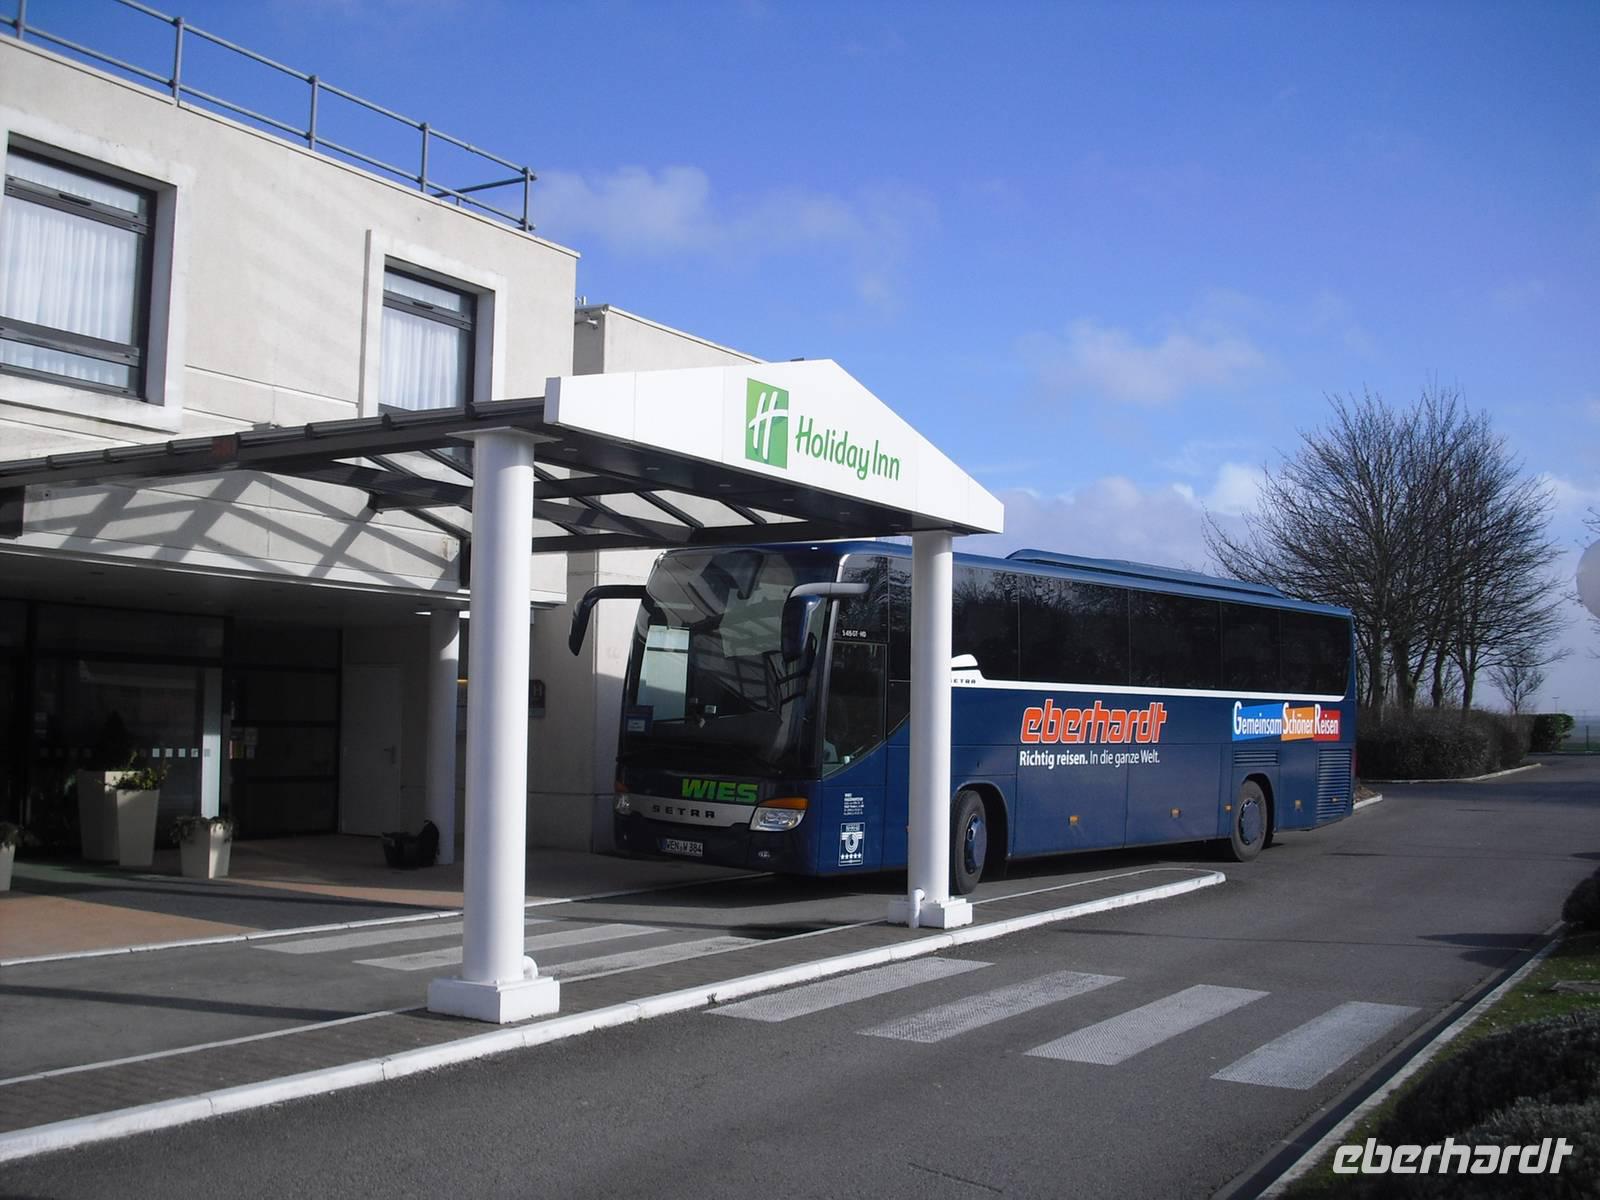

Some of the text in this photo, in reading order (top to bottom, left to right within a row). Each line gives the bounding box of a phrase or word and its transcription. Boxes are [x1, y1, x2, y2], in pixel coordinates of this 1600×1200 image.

[795, 415, 900, 481] Holiday Inn
[1020, 699, 1167, 744] eberhardt
[1233, 701, 1339, 735] Gemeinsam Schöner Reisen
[1019, 749, 1160, 769] Richtig reisen. In die ganze Welt.
[682, 778, 759, 803] WIES
[651, 804, 716, 818] SETRA
